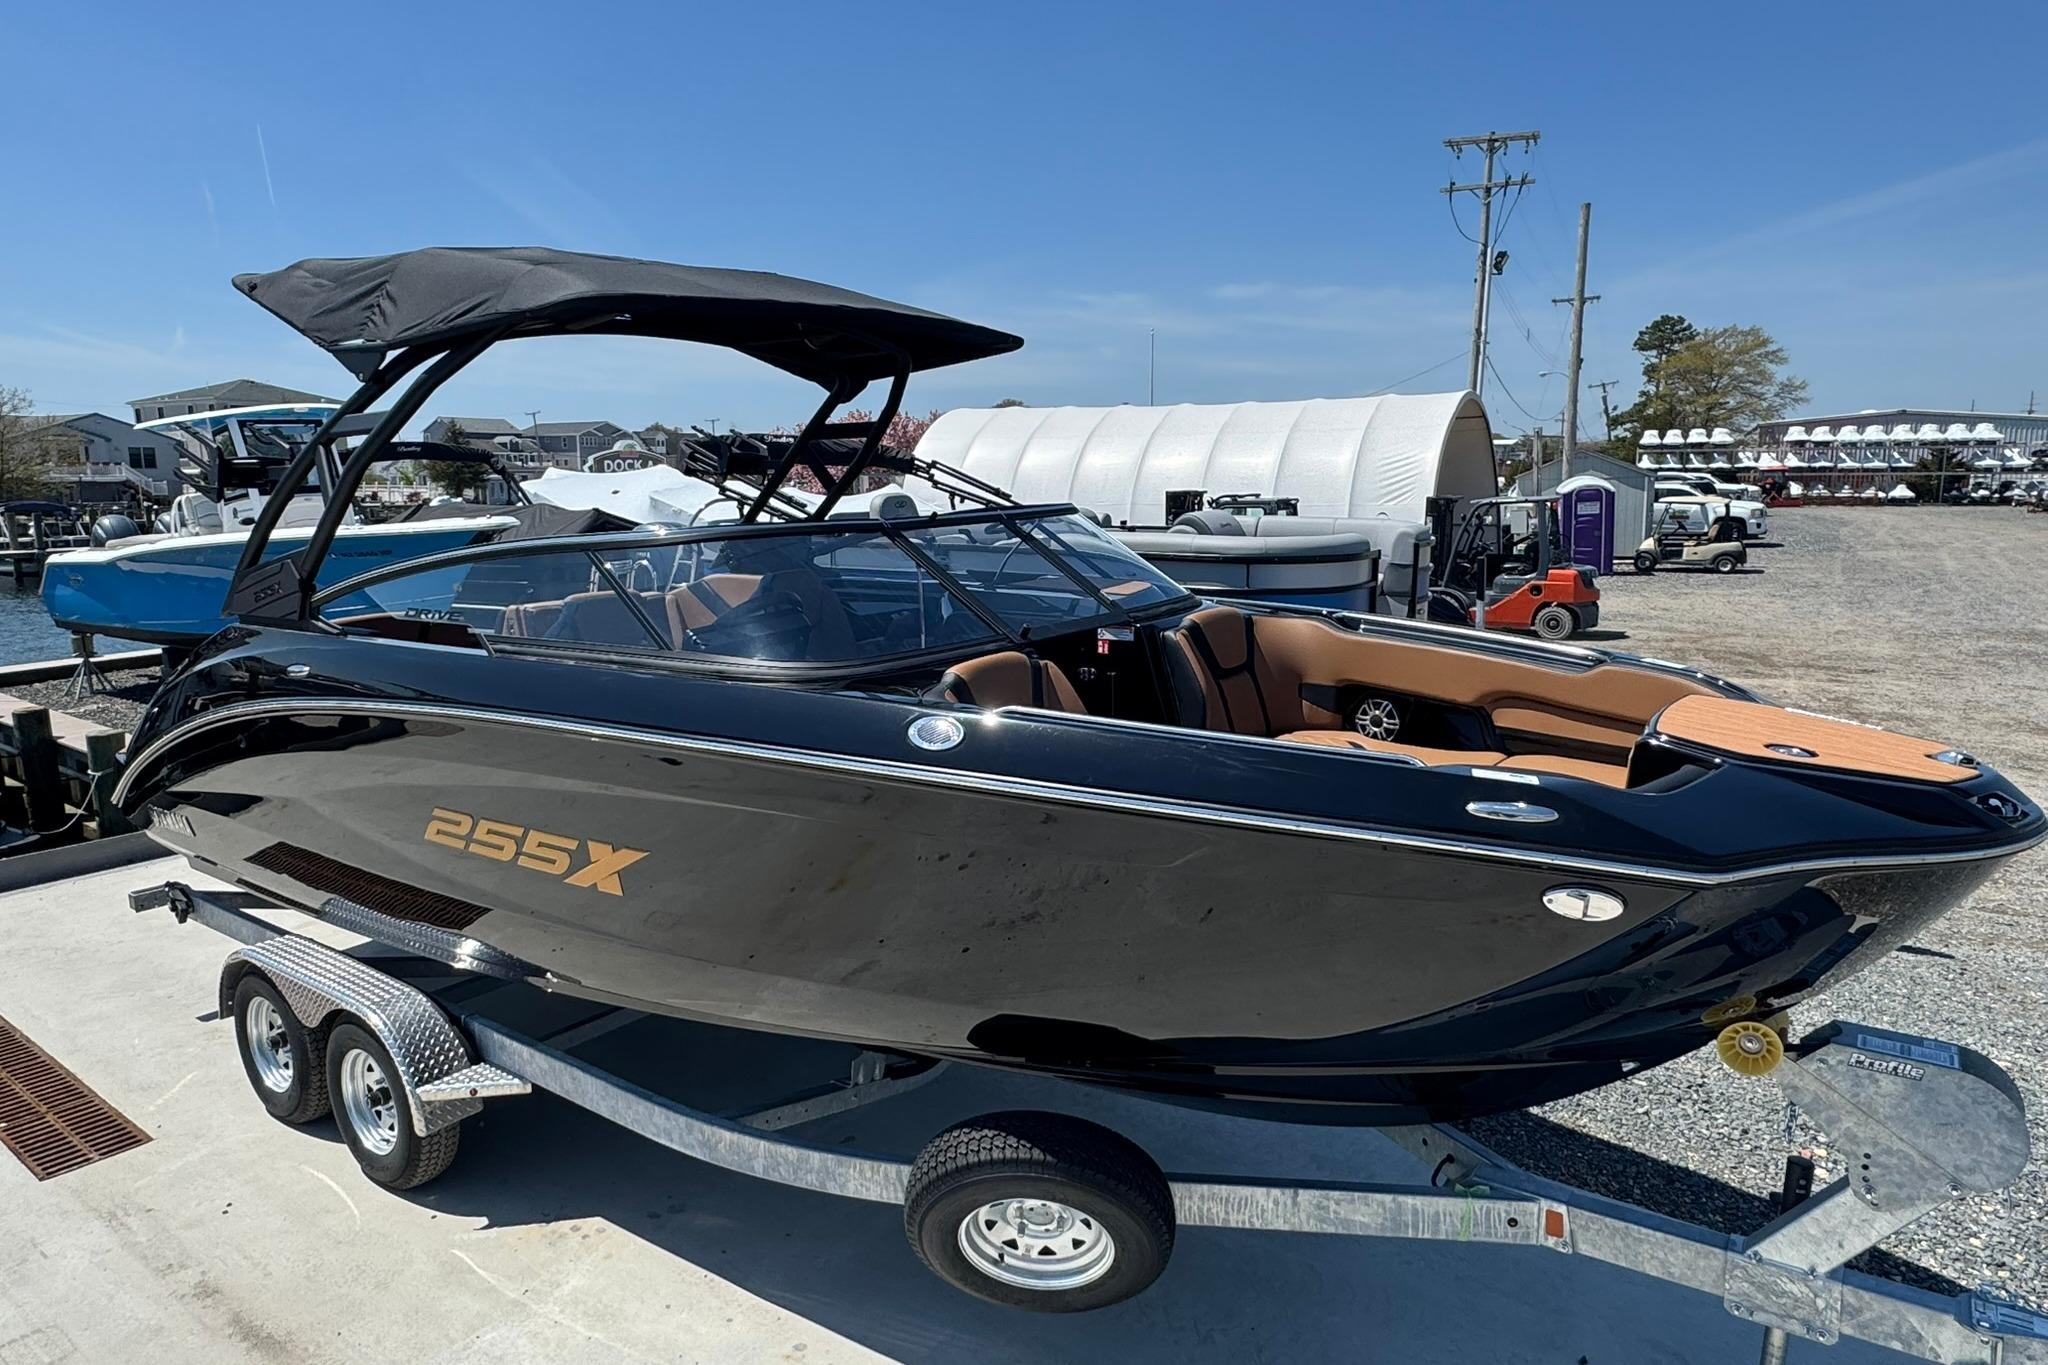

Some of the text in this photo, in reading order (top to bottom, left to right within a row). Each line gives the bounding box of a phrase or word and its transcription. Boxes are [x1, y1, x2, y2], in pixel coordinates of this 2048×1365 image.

[604, 460, 642, 472] DOCK
[424, 806, 650, 896] 255X
[1850, 1053, 1925, 1077] Profile
